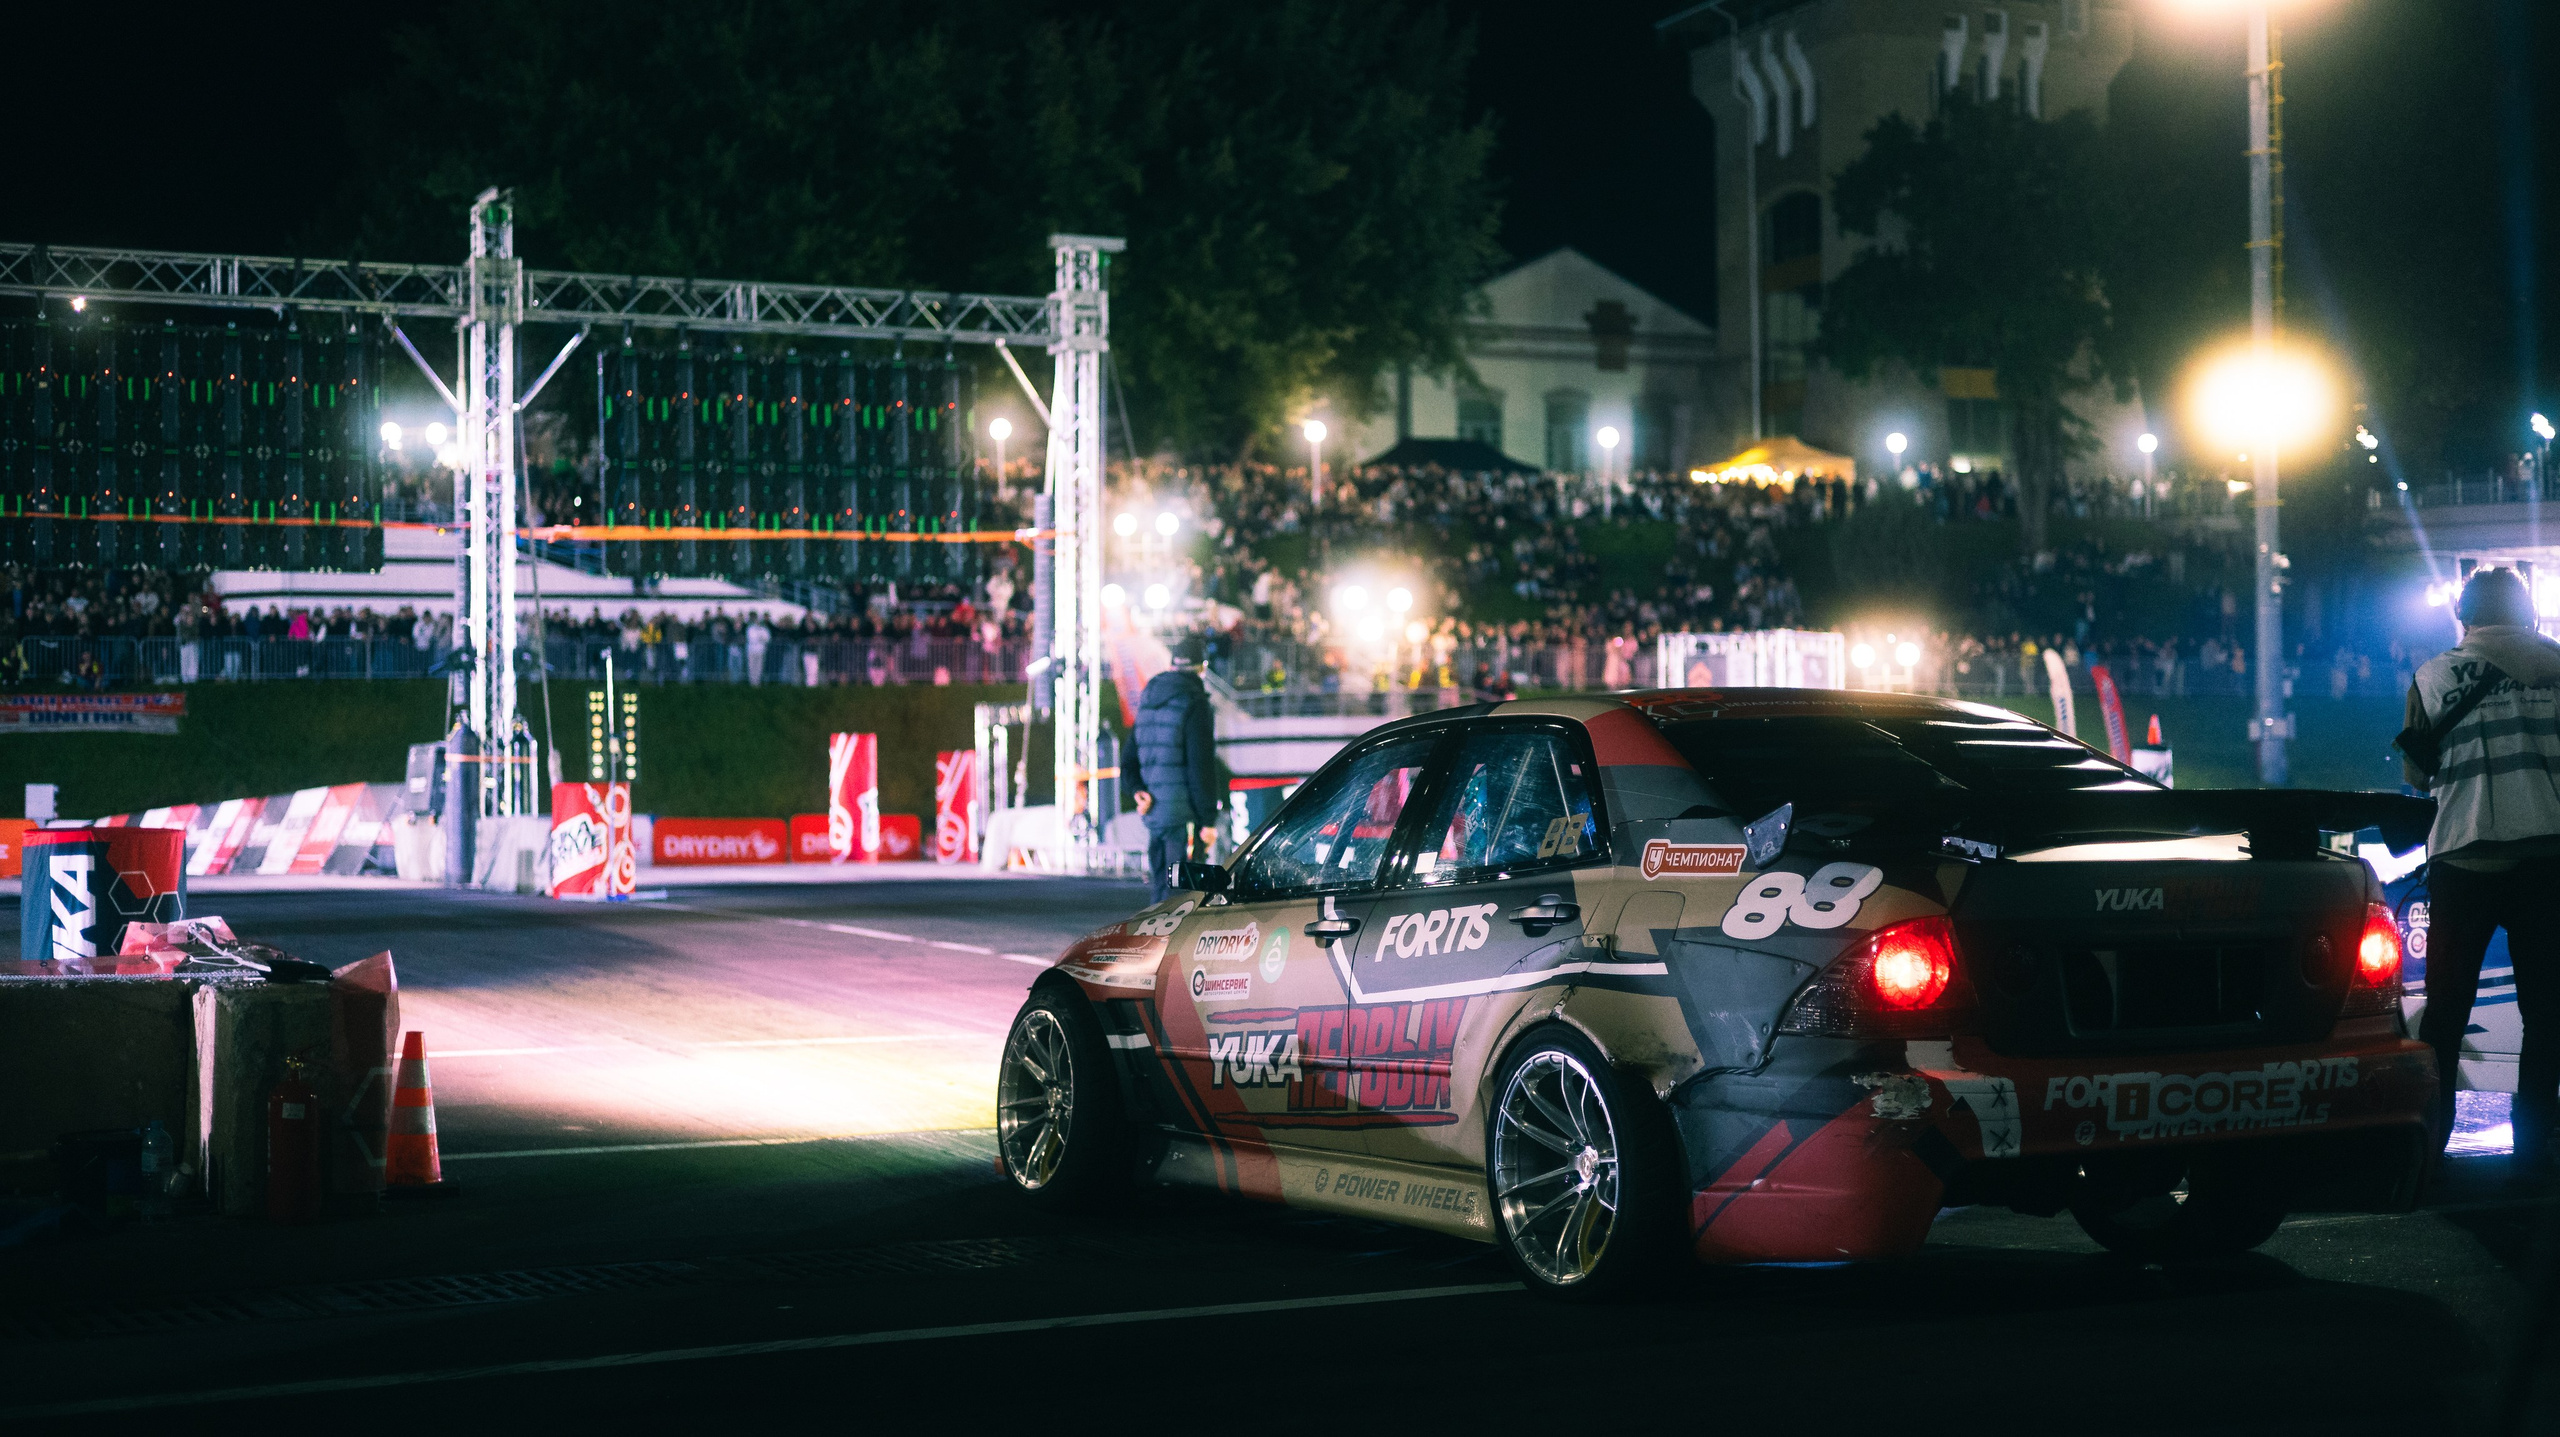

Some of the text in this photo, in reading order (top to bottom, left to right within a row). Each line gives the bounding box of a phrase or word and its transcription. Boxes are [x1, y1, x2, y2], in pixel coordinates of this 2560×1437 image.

[1536, 812, 1590, 860] 88
[1665, 852, 1742, 868] ЧЕМПИОНАТ
[1721, 861, 1884, 940] 88
[2095, 887, 2164, 911] YUKA
[1133, 900, 1195, 937] 88
[1375, 902, 1499, 962] FORTIS
[1196, 935, 1244, 955] DRYDRY
[1204, 979, 1248, 991] ШИНСЕРВИС
[1208, 1032, 1303, 1087] YUKA
[1333, 1173, 1477, 1213] POWER WHEELS
